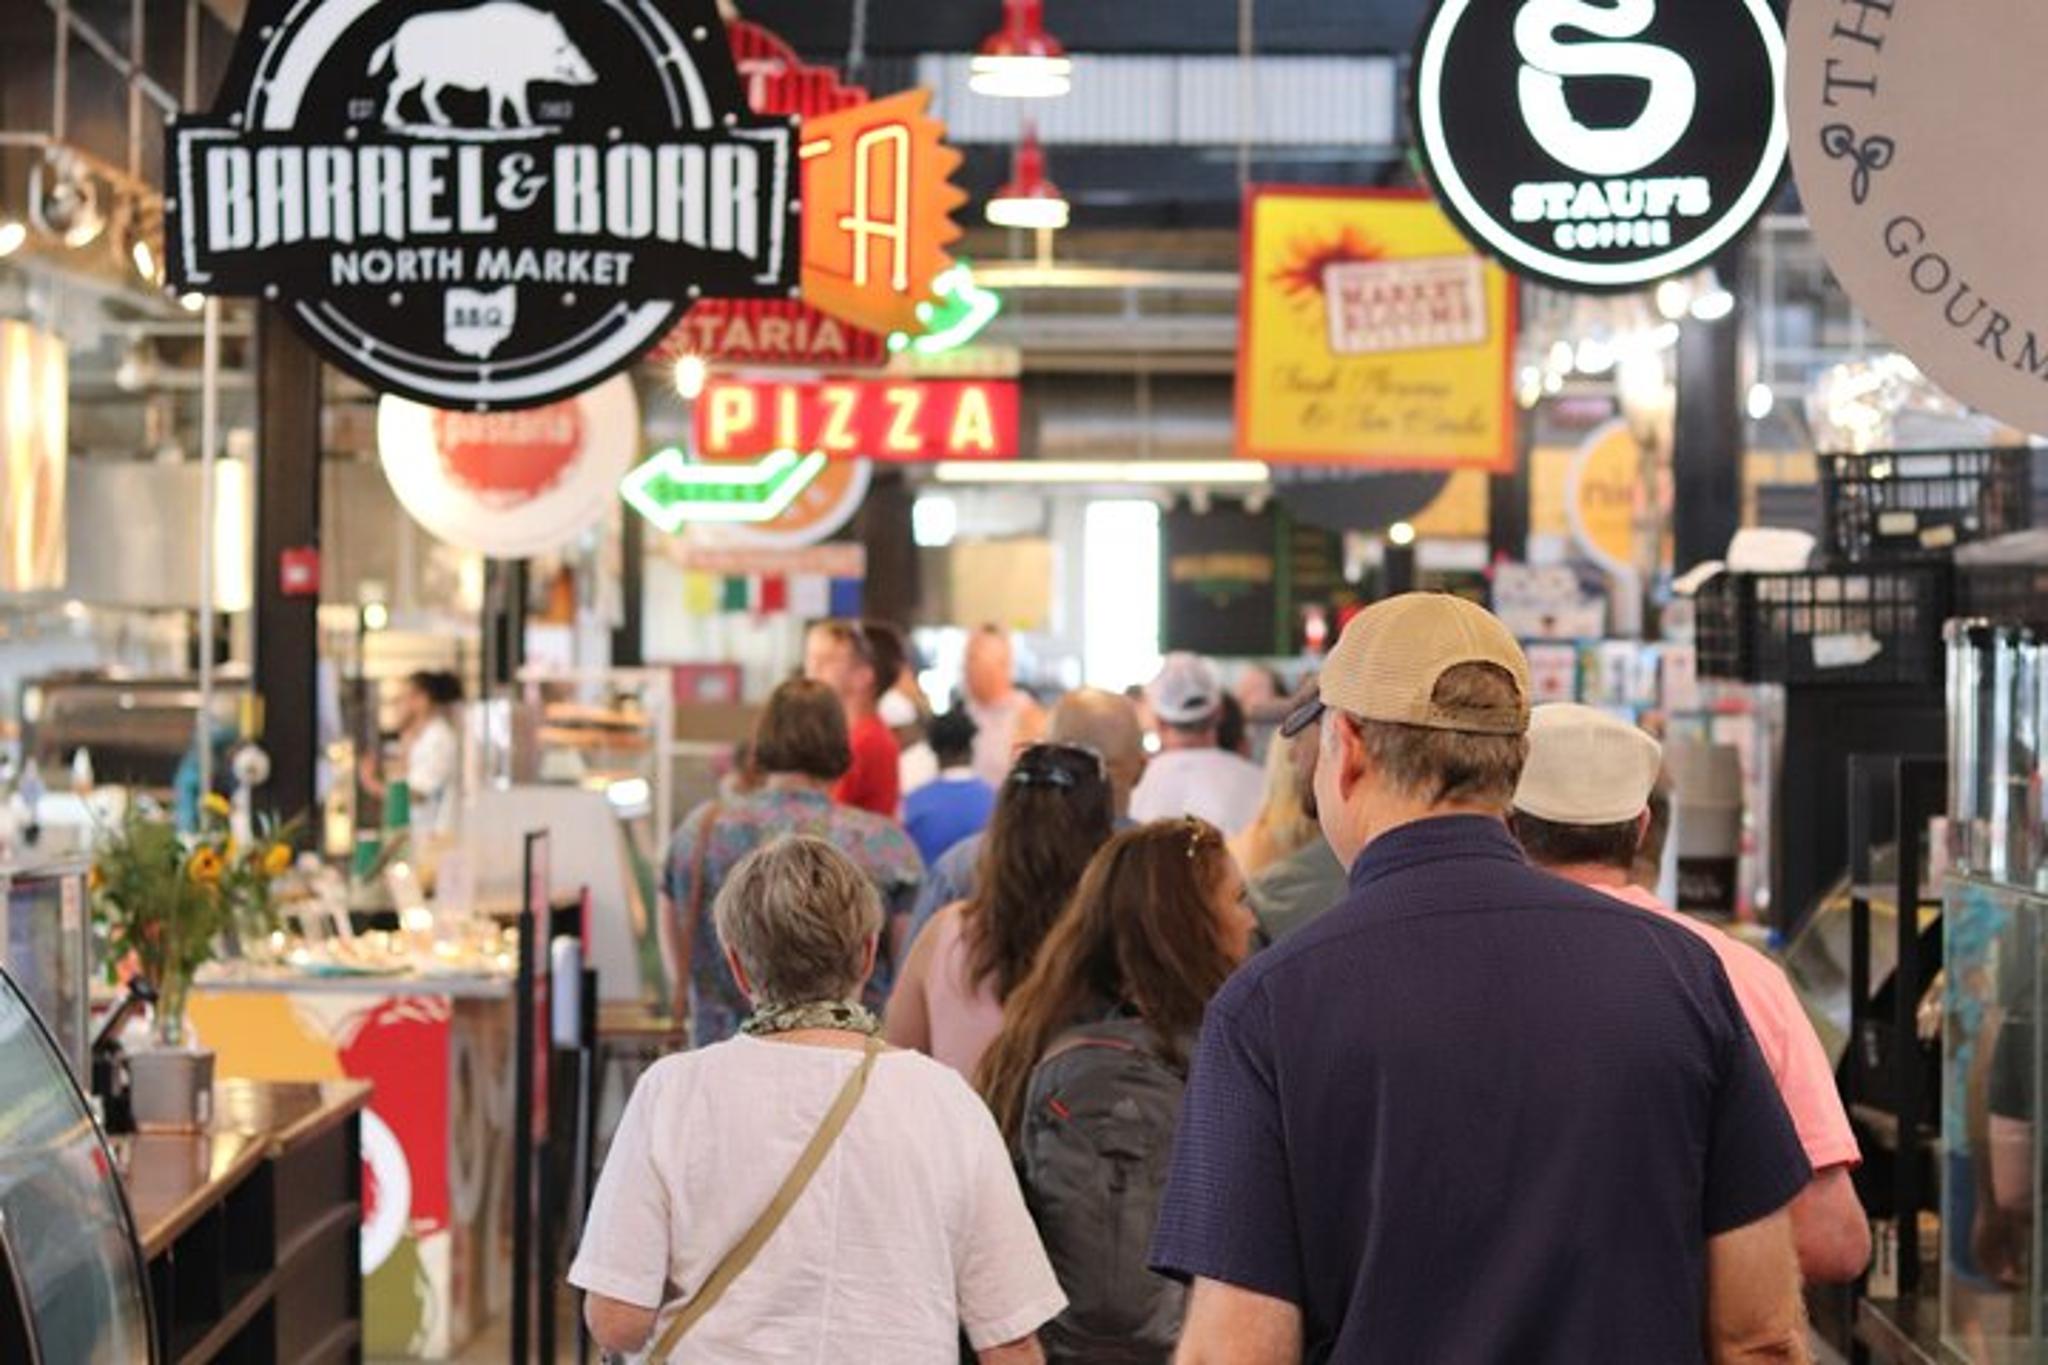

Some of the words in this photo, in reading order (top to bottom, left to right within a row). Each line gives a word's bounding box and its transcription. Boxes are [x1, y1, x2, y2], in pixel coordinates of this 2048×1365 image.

[206, 145, 498, 252] BARREL
[495, 153, 547, 210] &
[554, 144, 759, 260] BOAR
[1553, 218, 1671, 250] COFFEE
[331, 248, 463, 285] NORTH
[475, 248, 633, 286] MARKET
[455, 306, 502, 328] BBQ
[707, 385, 996, 451] PIZZA
